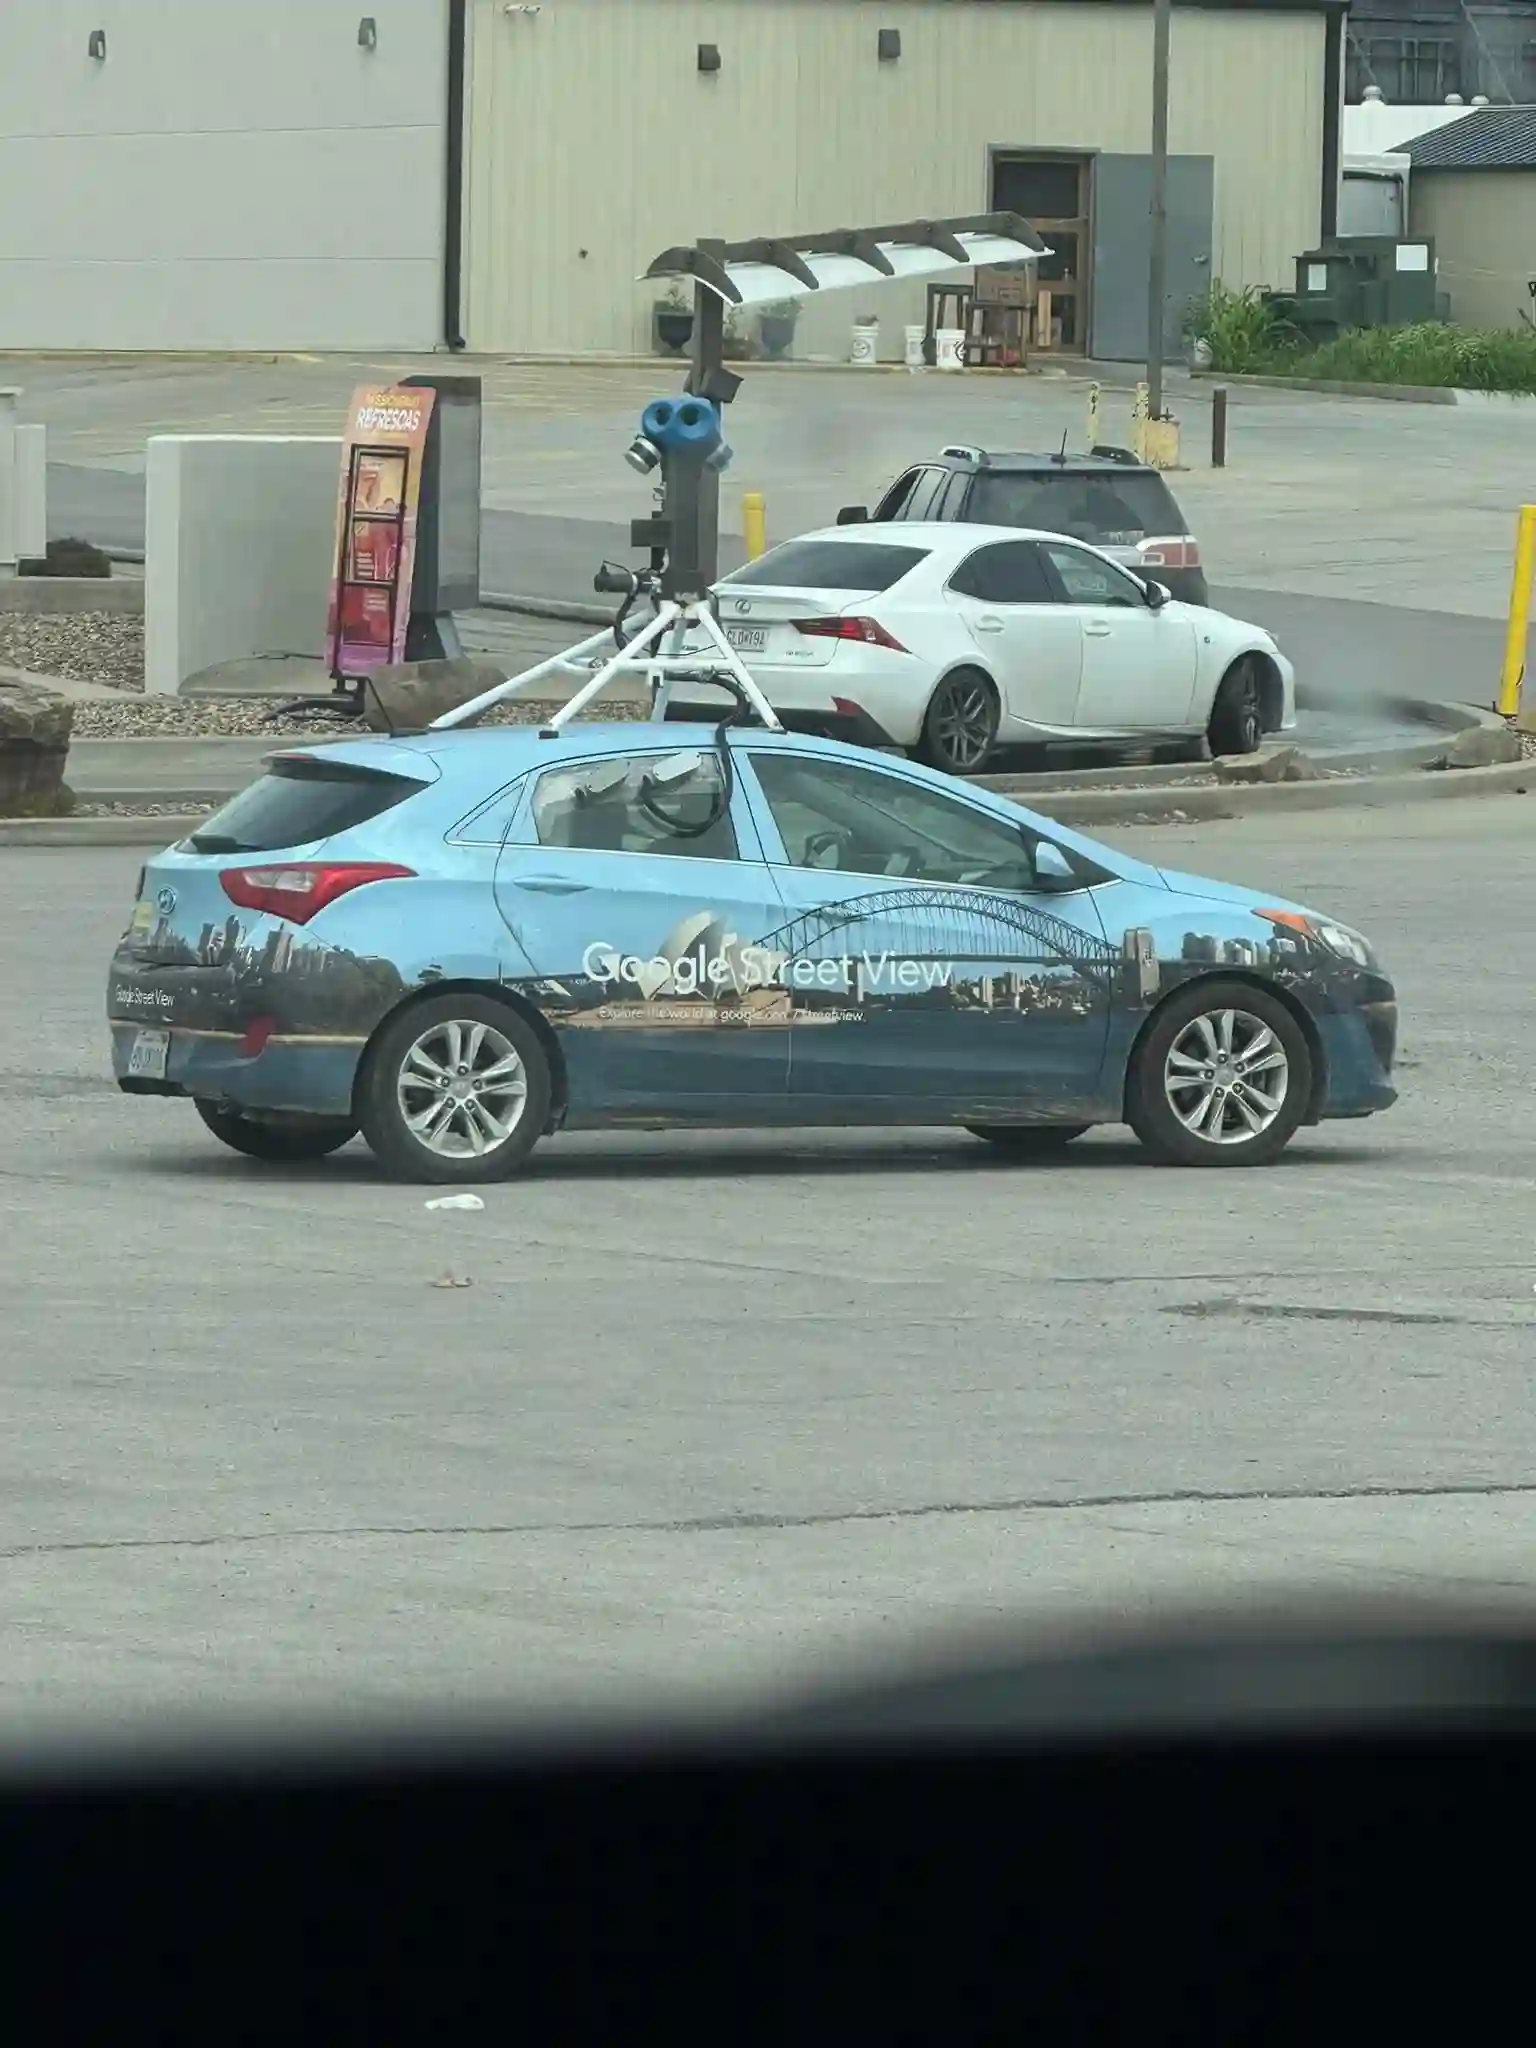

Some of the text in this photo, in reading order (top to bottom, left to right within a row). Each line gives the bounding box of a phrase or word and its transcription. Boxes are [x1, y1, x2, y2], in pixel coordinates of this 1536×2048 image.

[356, 407, 421, 431] REFRESCAS
[582, 941, 953, 995] Google Street View
[155, 988, 175, 1007] View
[600, 1005, 643, 1021] Expore
[668, 1005, 704, 1020] wold
